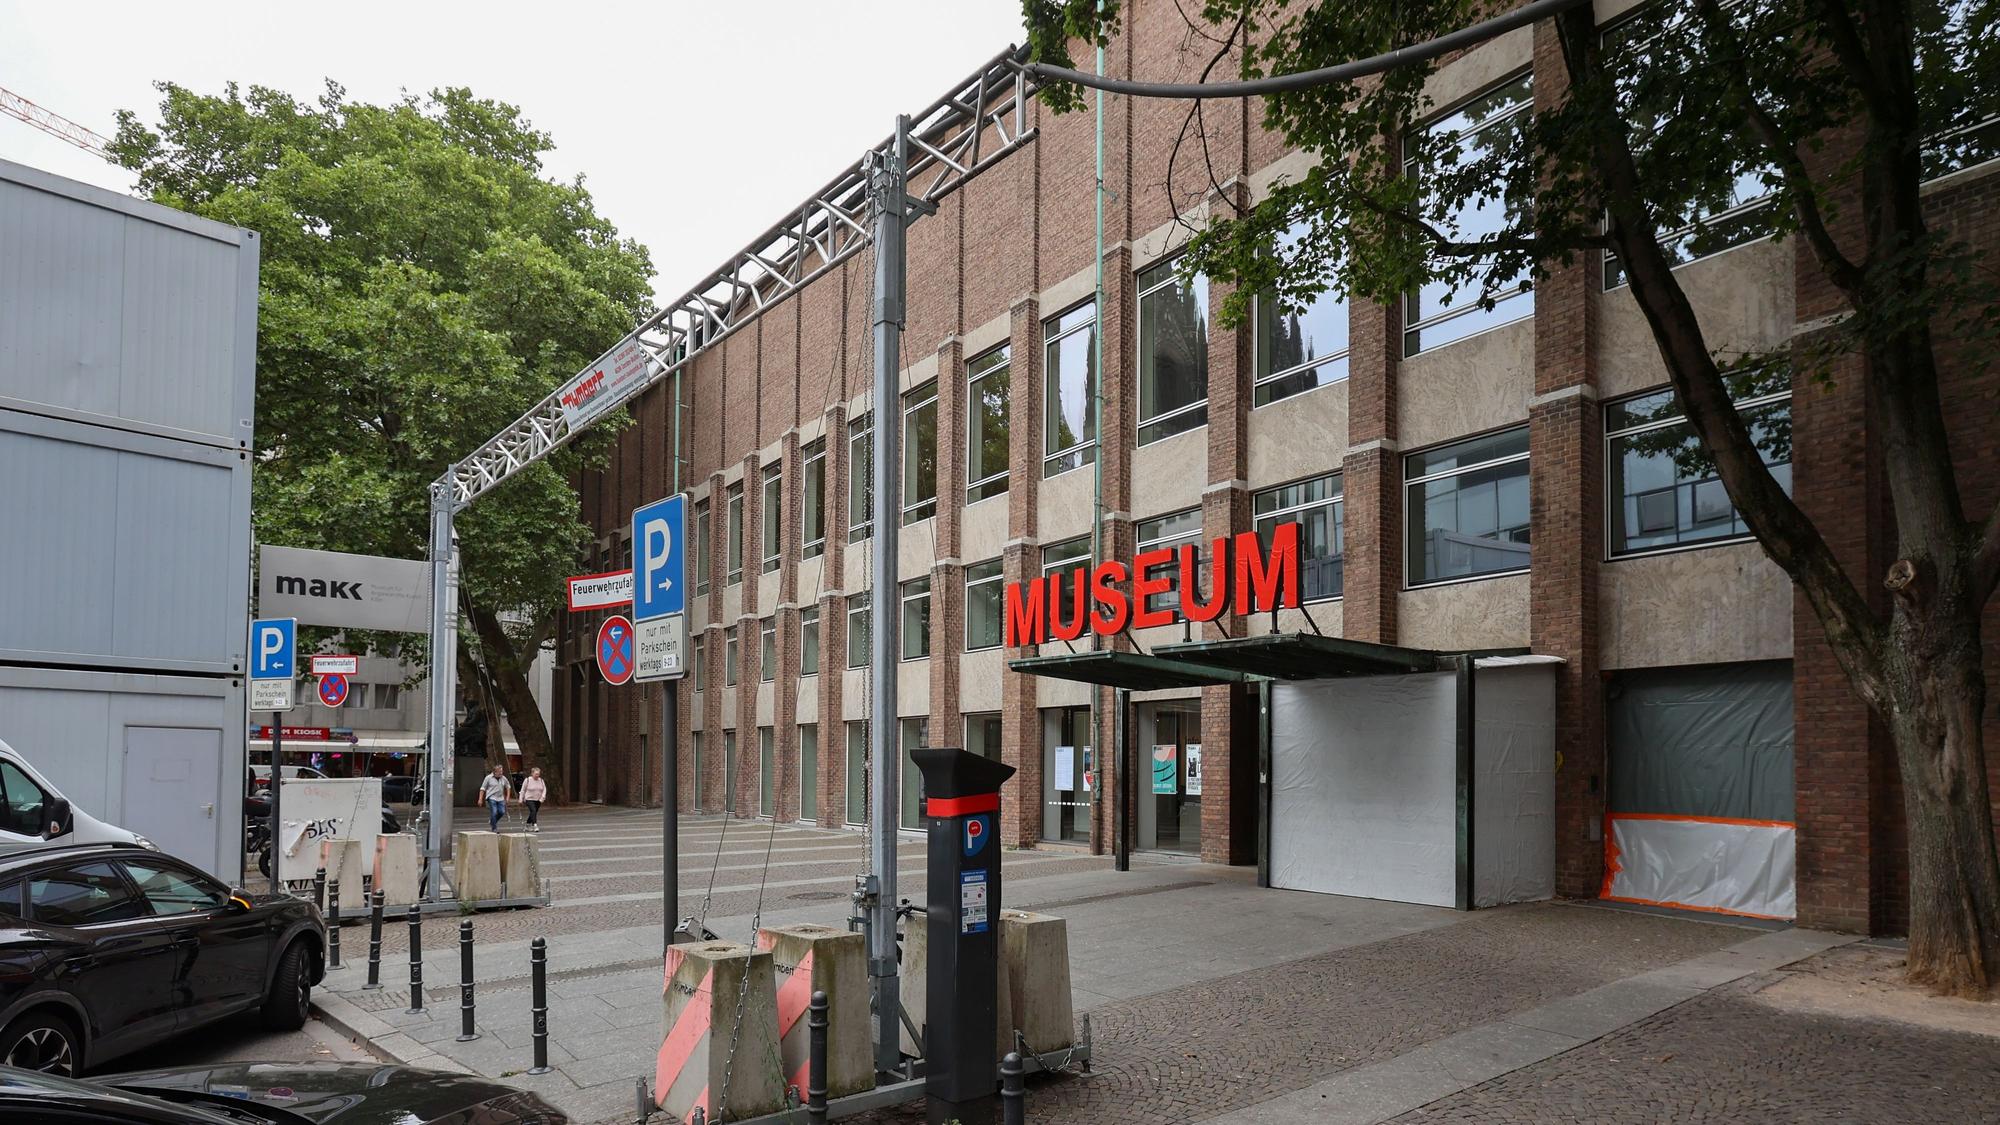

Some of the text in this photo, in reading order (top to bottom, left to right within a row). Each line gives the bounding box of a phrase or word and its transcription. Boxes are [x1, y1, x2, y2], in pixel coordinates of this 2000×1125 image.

[644, 518, 671, 604] P
[573, 578, 633, 596] Feuerwehrzufah
[1006, 521, 1303, 648] MUSEUM
[645, 622, 672, 637] nur mit
[260, 627, 284, 671] P
[641, 639, 677, 655] Parkschein
[314, 658, 355, 667] Feuerwehrzufahrt
[640, 657, 662, 672] werktags
[675, 654, 680, 667] h
